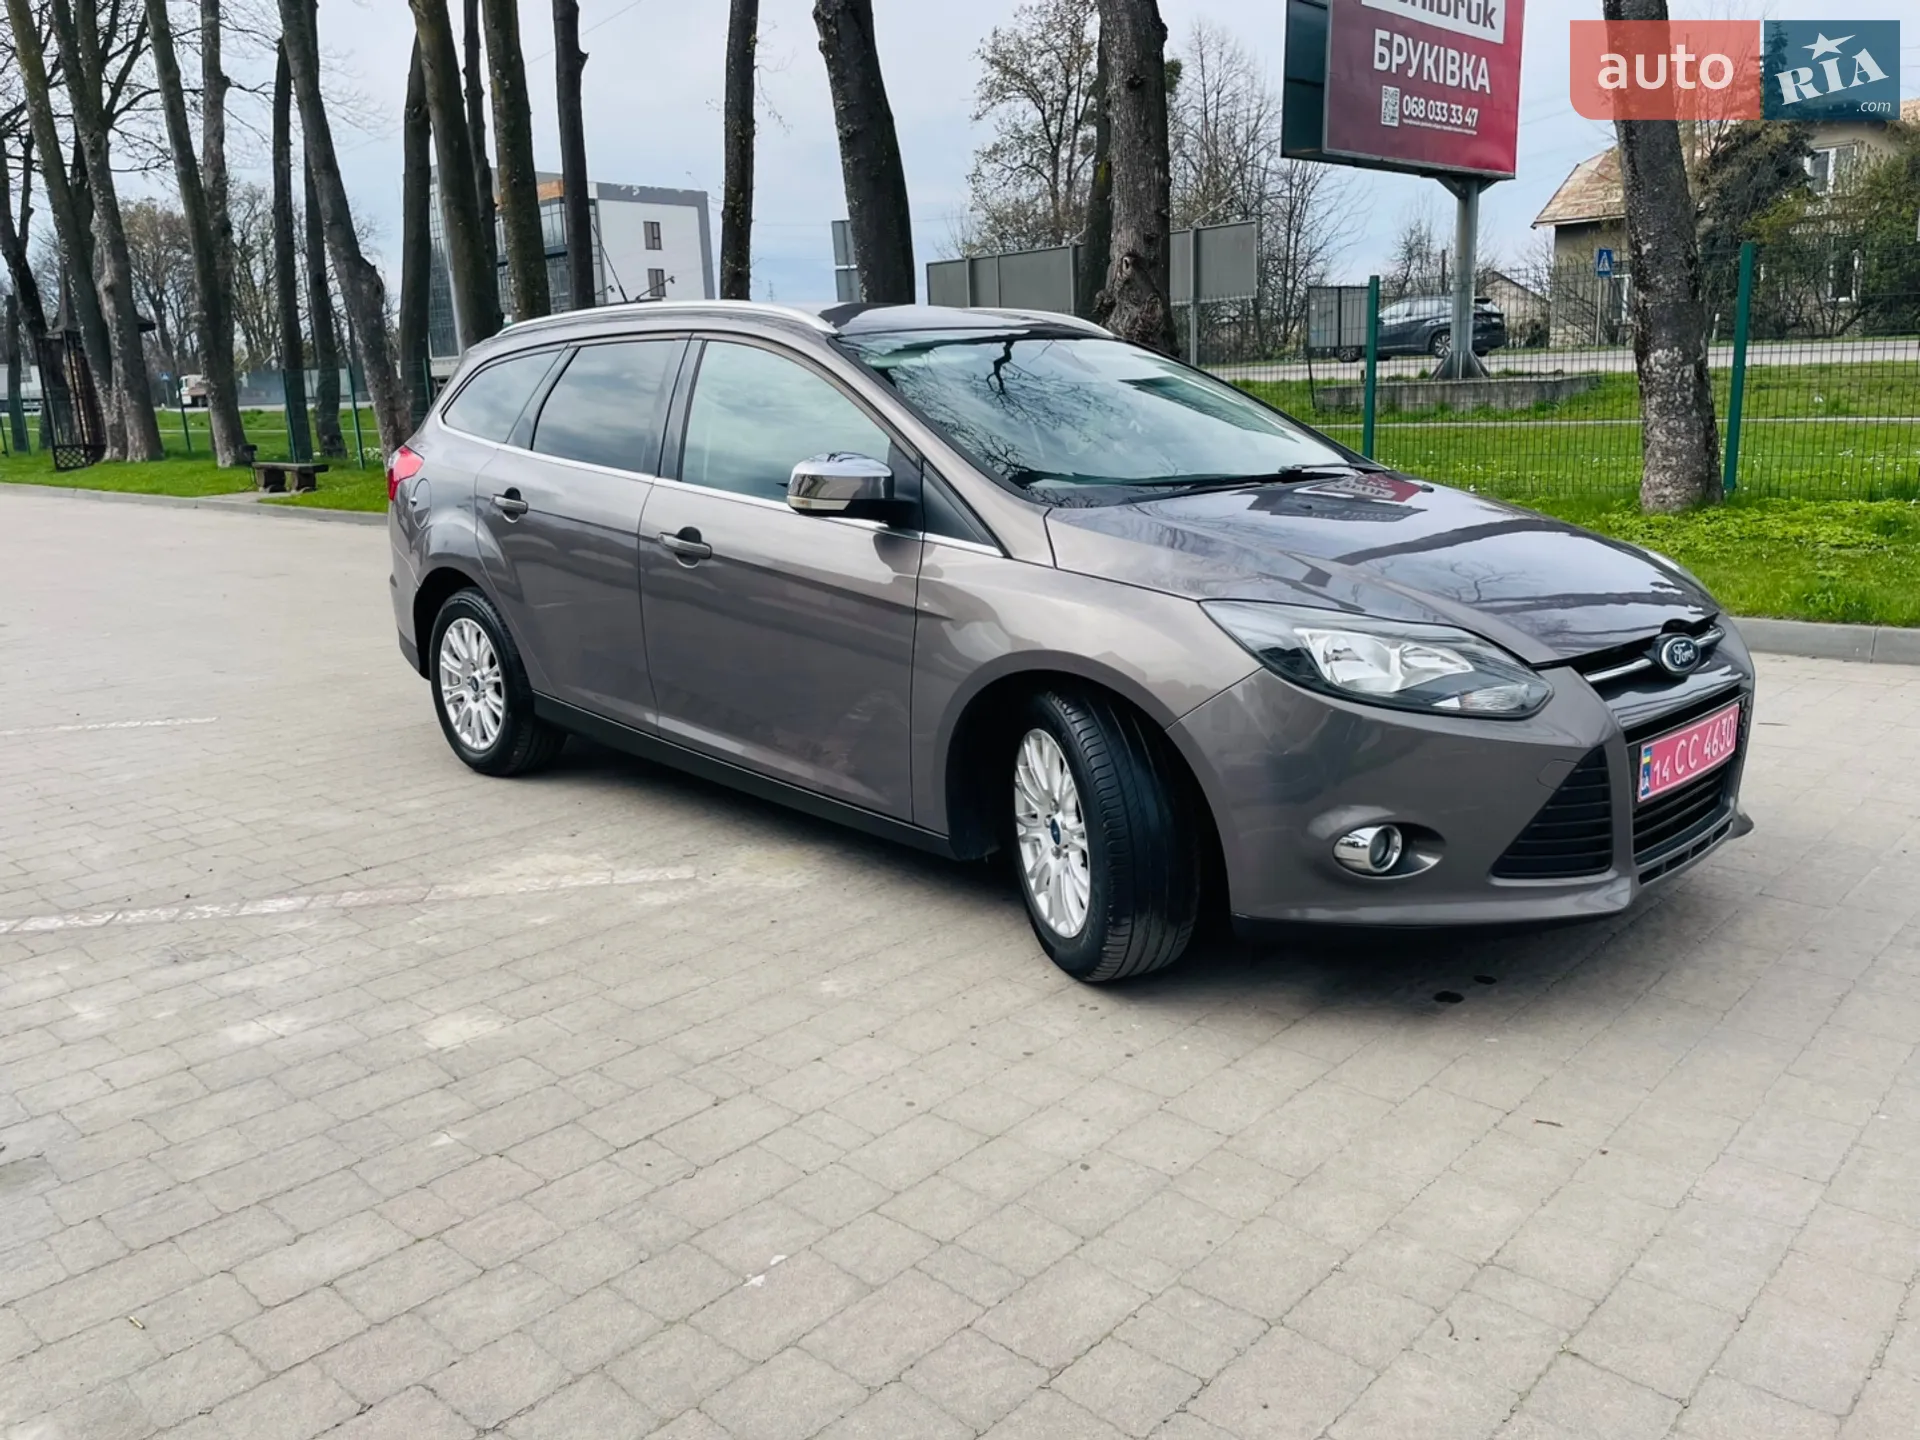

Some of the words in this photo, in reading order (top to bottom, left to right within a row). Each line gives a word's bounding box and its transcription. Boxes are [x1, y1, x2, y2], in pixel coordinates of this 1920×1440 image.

[1373, 28, 1491, 94] БРУКІВКА
[1402, 95, 1425, 118] 068
[1427, 100, 1448, 122] 033
[1449, 104, 1463, 125] 33
[1465, 107, 1479, 127] 47
[1673, 642, 1695, 665] Ford
[1653, 755, 1670, 786] 14
[1674, 733, 1699, 775] CC
[1703, 714, 1734, 760] 4630
